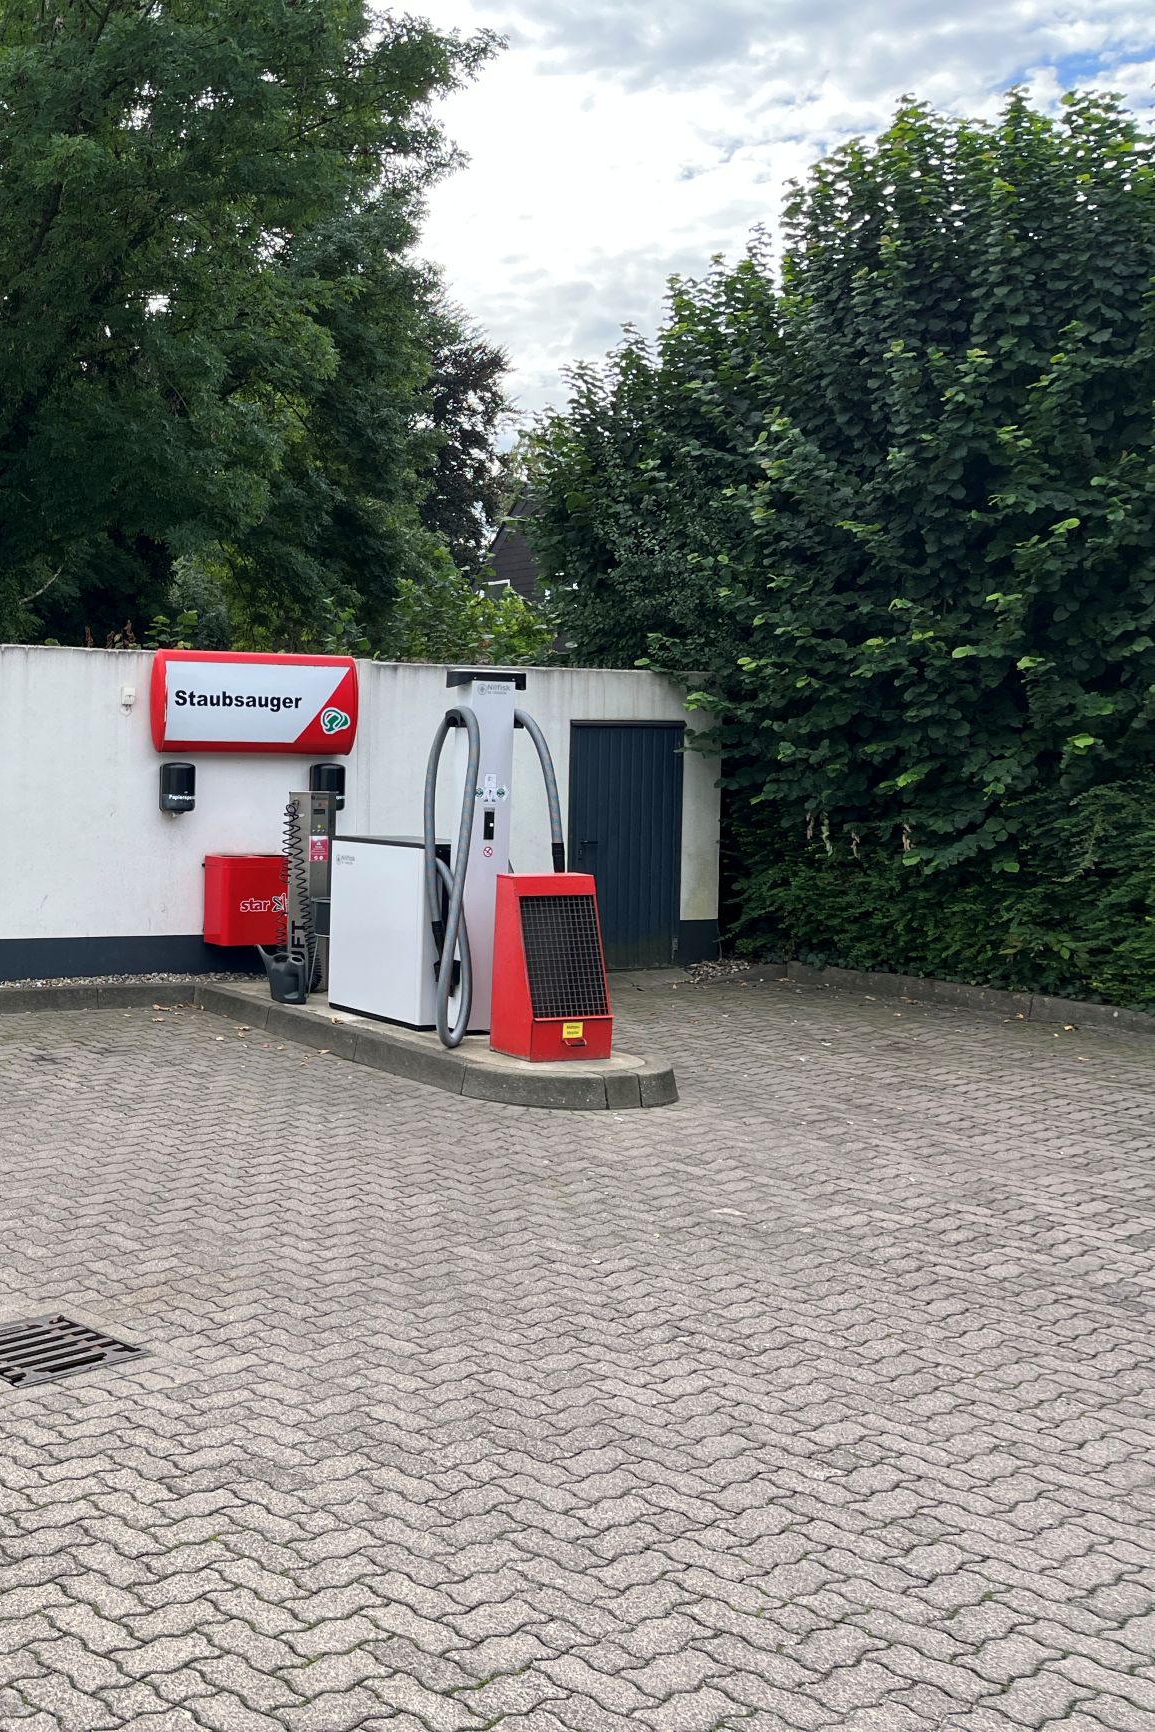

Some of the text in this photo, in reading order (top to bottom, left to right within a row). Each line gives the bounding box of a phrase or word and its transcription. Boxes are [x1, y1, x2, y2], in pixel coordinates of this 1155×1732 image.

[487, 683, 511, 692] Nilfisk
[174, 690, 302, 712] Staubsauger
[240, 897, 270, 912] star
